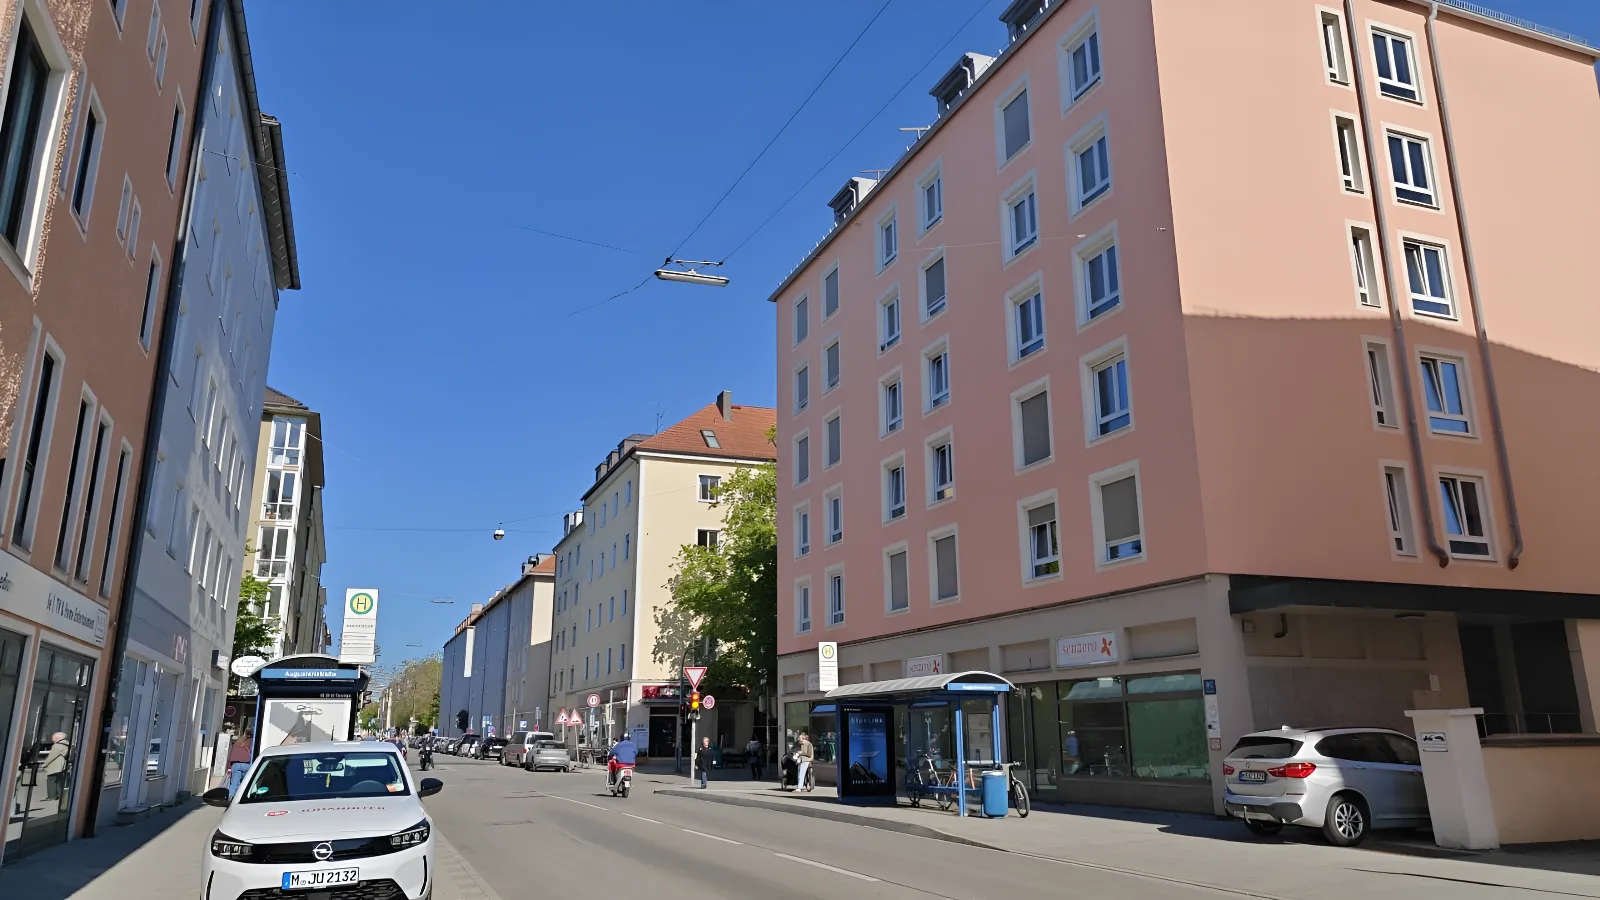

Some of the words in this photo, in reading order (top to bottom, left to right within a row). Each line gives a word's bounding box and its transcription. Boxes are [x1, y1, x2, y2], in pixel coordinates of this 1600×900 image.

[356, 597, 367, 611] H
[291, 874, 299, 886] M
[308, 872, 325, 885] JU
[327, 869, 357, 883] 2132
